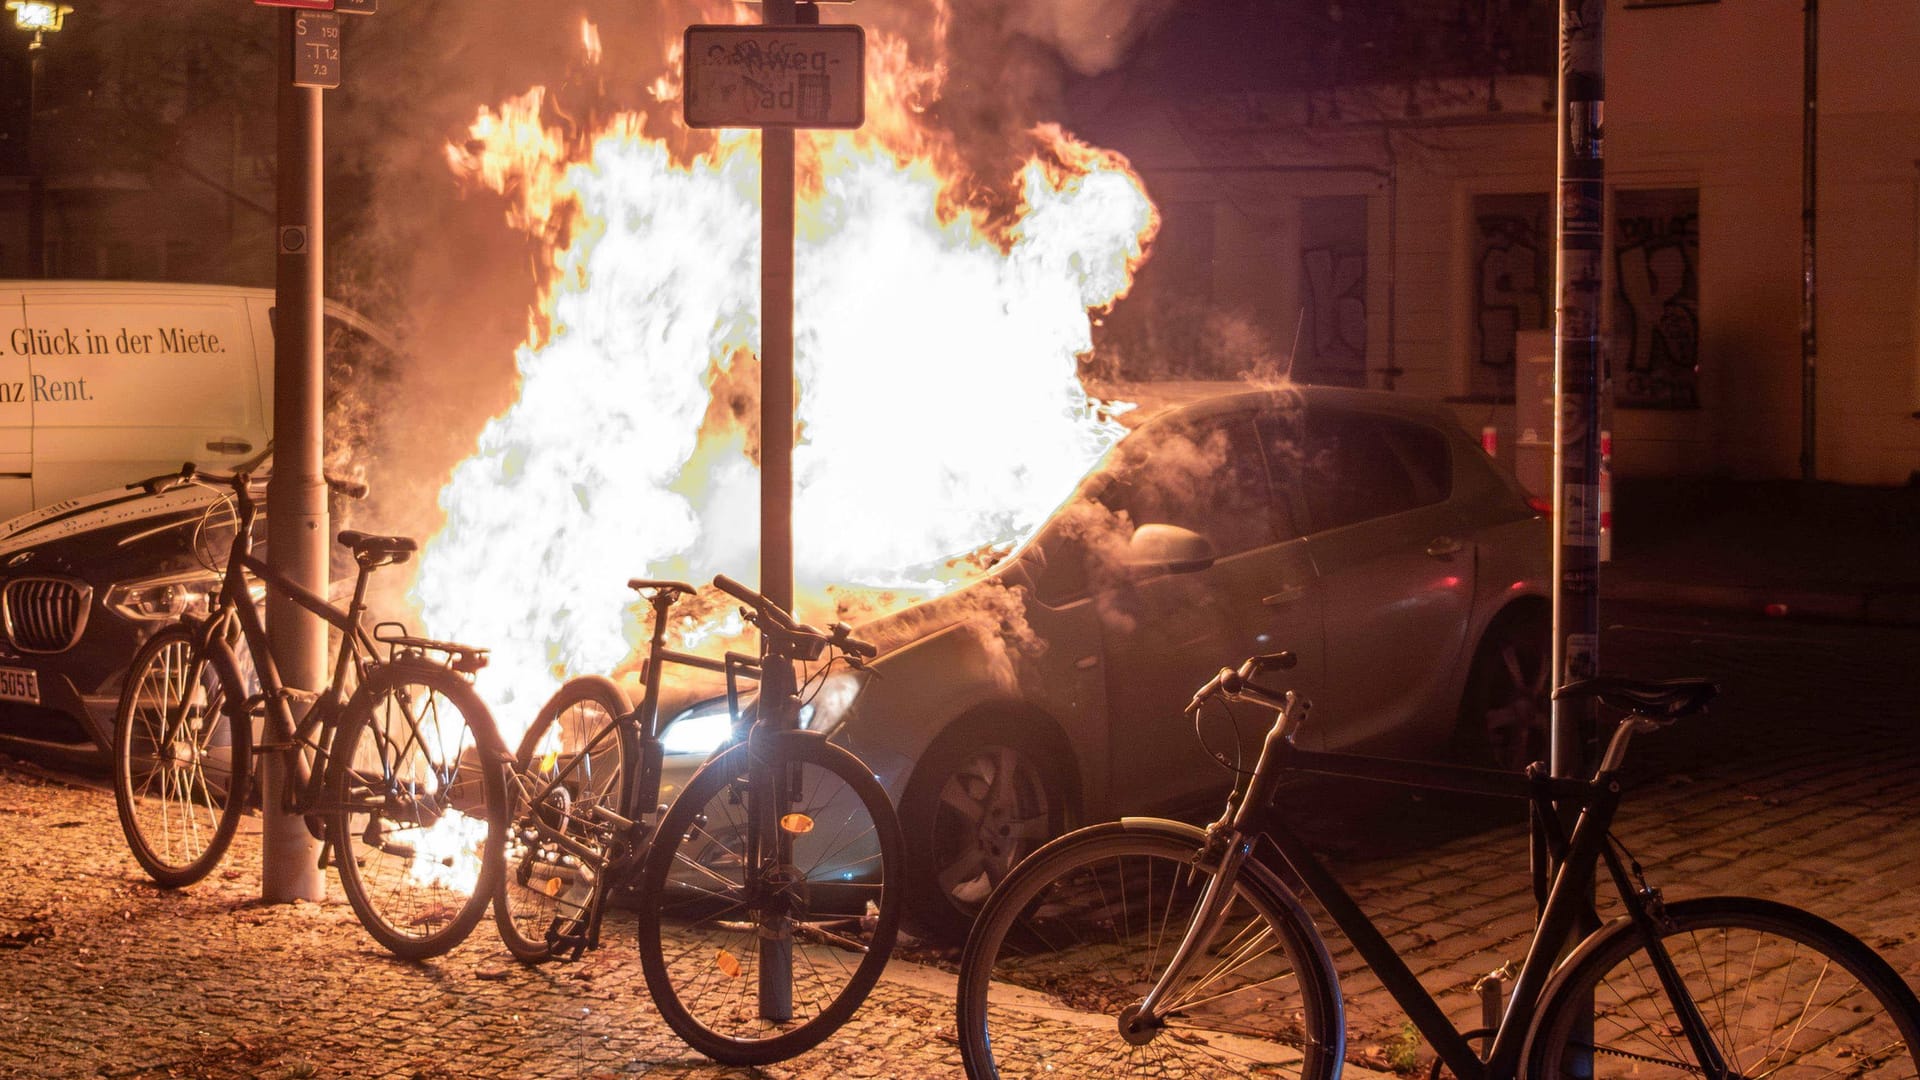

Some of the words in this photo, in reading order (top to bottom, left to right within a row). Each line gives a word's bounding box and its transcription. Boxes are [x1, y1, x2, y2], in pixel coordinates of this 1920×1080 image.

[296, 19, 307, 35] S
[322, 27, 338, 38] 150
[11, 328, 82, 355] Glück
[86, 328, 109, 354] in
[116, 328, 152, 354] der
[159, 328, 225, 353] Miete.
[31, 374, 94, 402] Rent.
